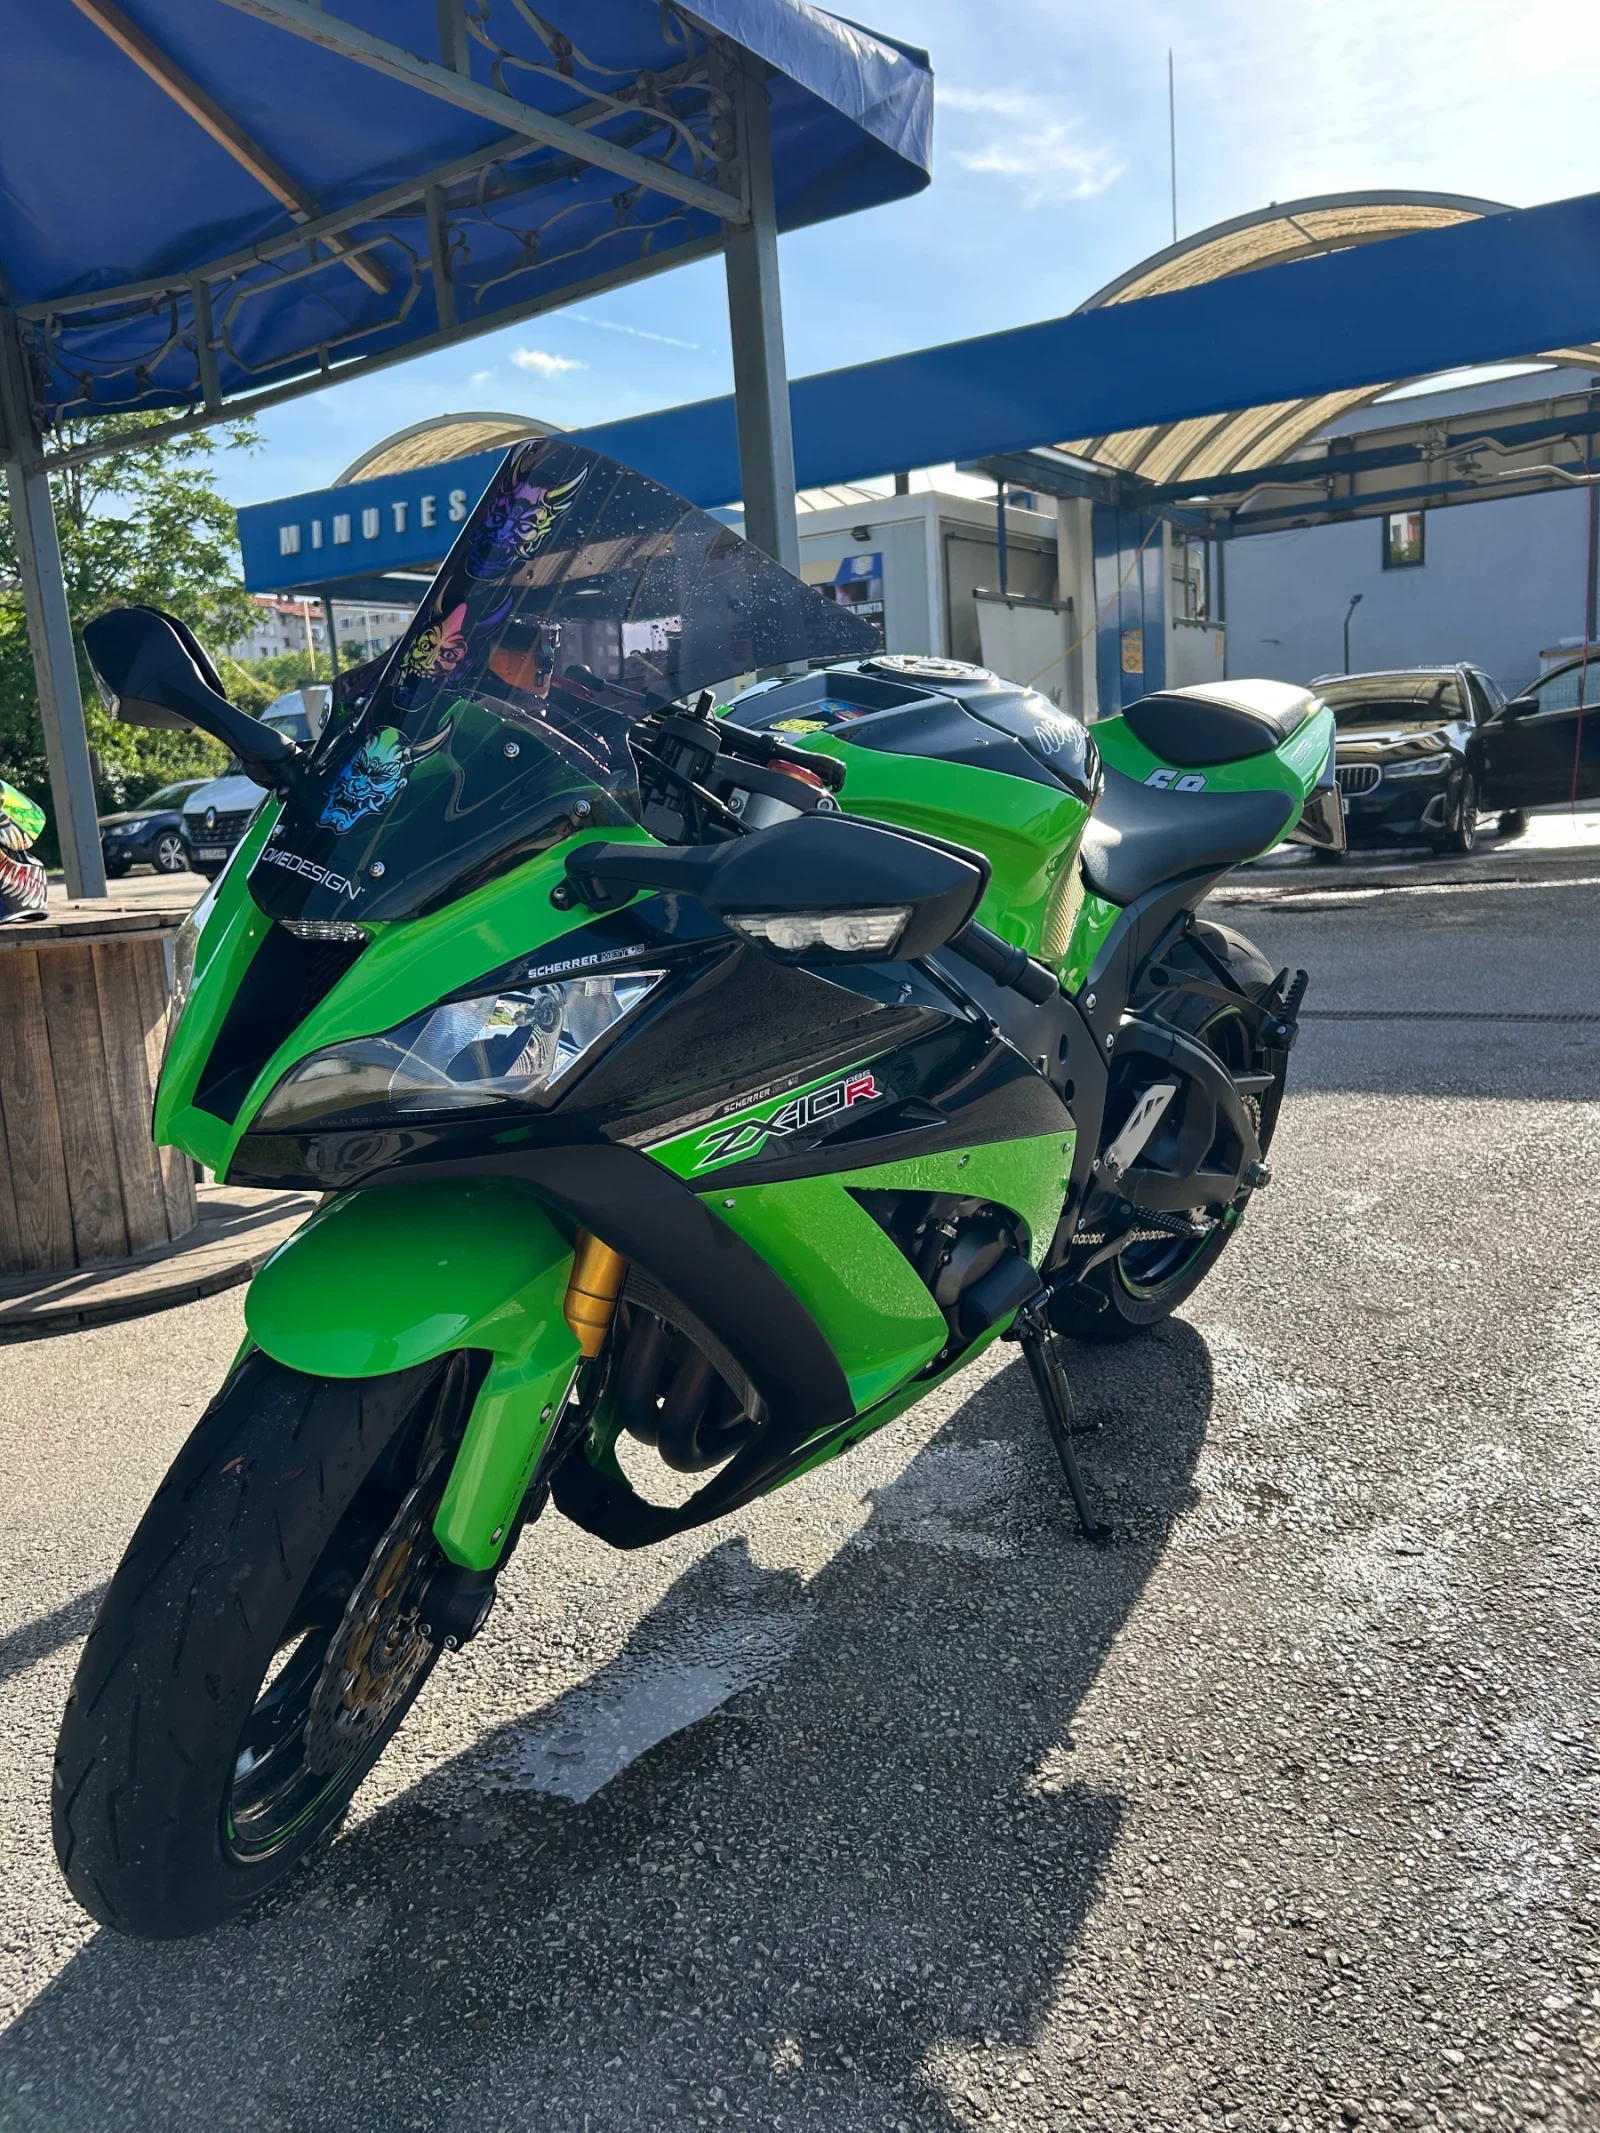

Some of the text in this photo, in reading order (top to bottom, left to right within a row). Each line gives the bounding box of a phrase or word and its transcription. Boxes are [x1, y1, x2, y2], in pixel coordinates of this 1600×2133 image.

[279, 489, 467, 555] MINUTES
[261, 847, 362, 900] ONEDESIGN
[528, 954, 599, 979] SCHERRER
[846, 1069, 871, 1084] ABS
[723, 1088, 771, 1114] SCHERRER
